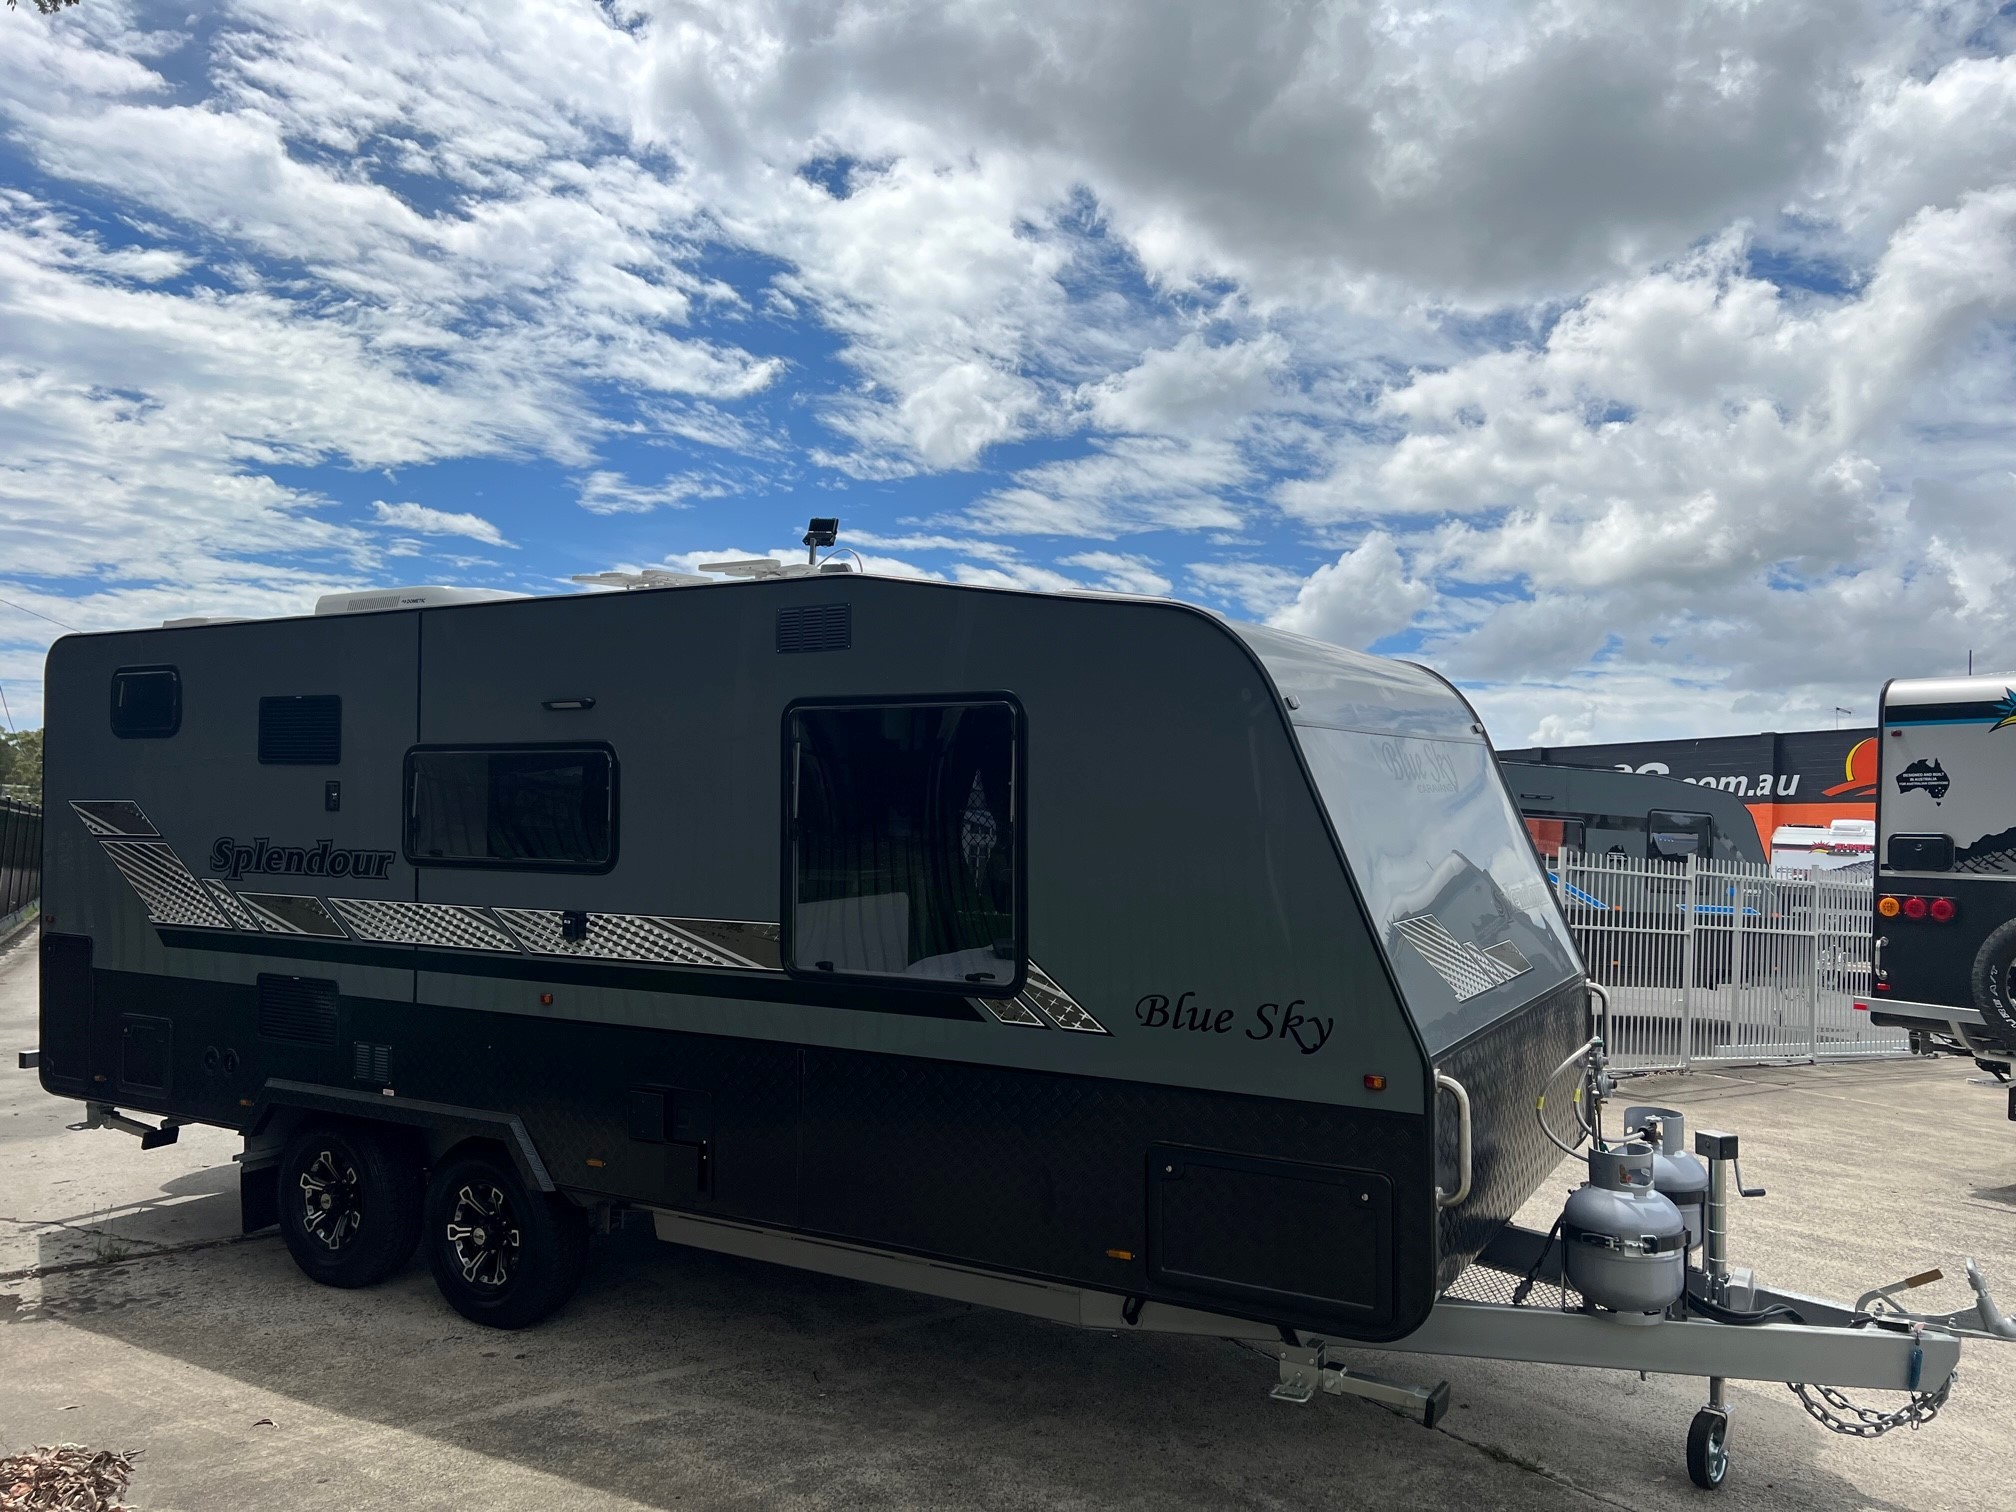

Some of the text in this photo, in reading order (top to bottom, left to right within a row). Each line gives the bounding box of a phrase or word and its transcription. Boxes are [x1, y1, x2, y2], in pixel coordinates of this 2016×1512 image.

[1382, 739, 1459, 793] Blue Sky
[210, 837, 396, 881] Splendour
[1135, 991, 1334, 1054] Blue Sky
